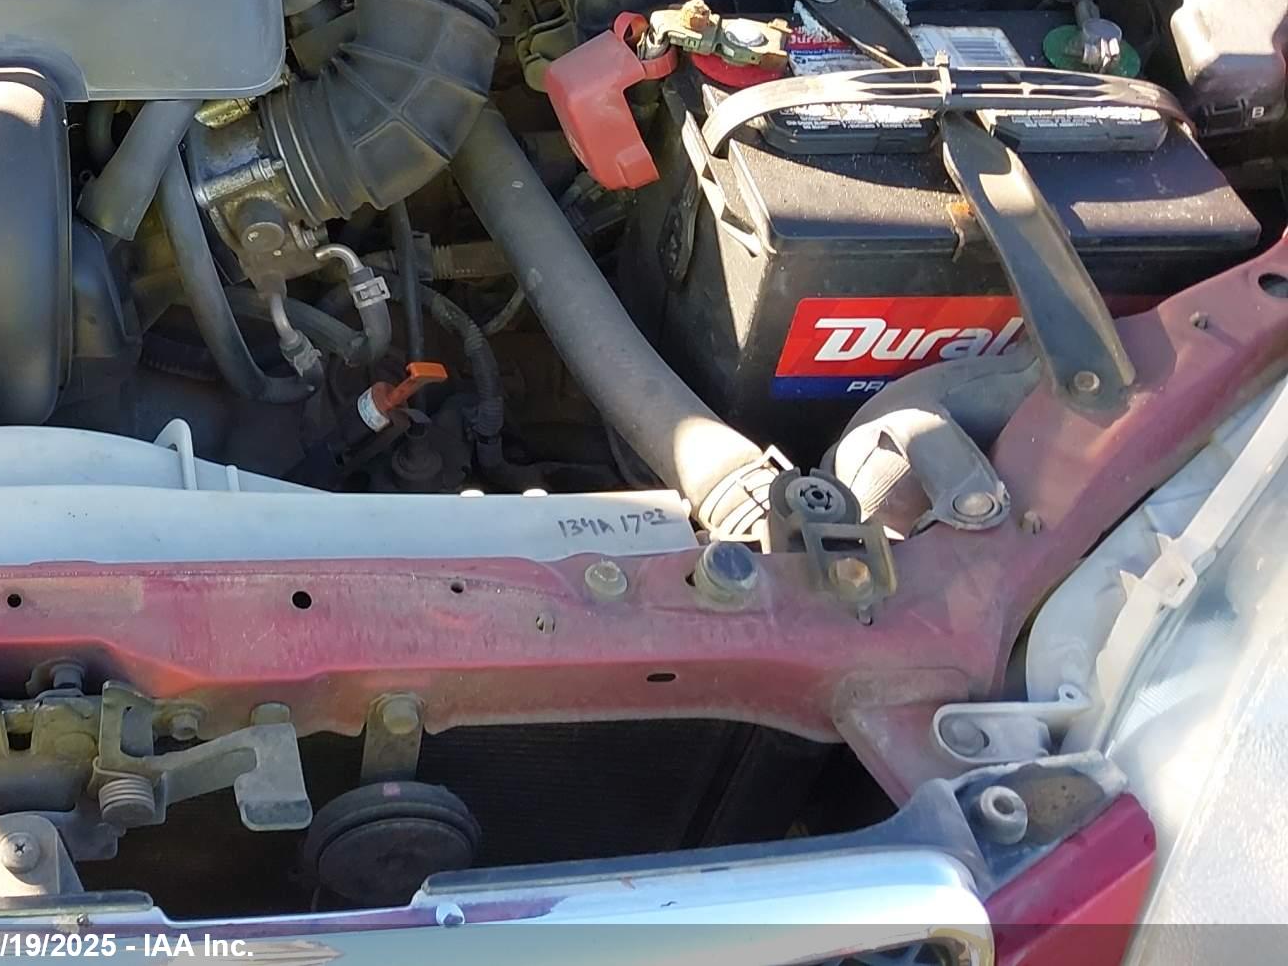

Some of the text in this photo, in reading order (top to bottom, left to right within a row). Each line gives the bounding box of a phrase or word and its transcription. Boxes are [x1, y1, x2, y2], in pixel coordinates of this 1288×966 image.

[1252, 106, 1264, 118] B
[814, 318, 1024, 361] Dural
[846, 381, 885, 393] PR
